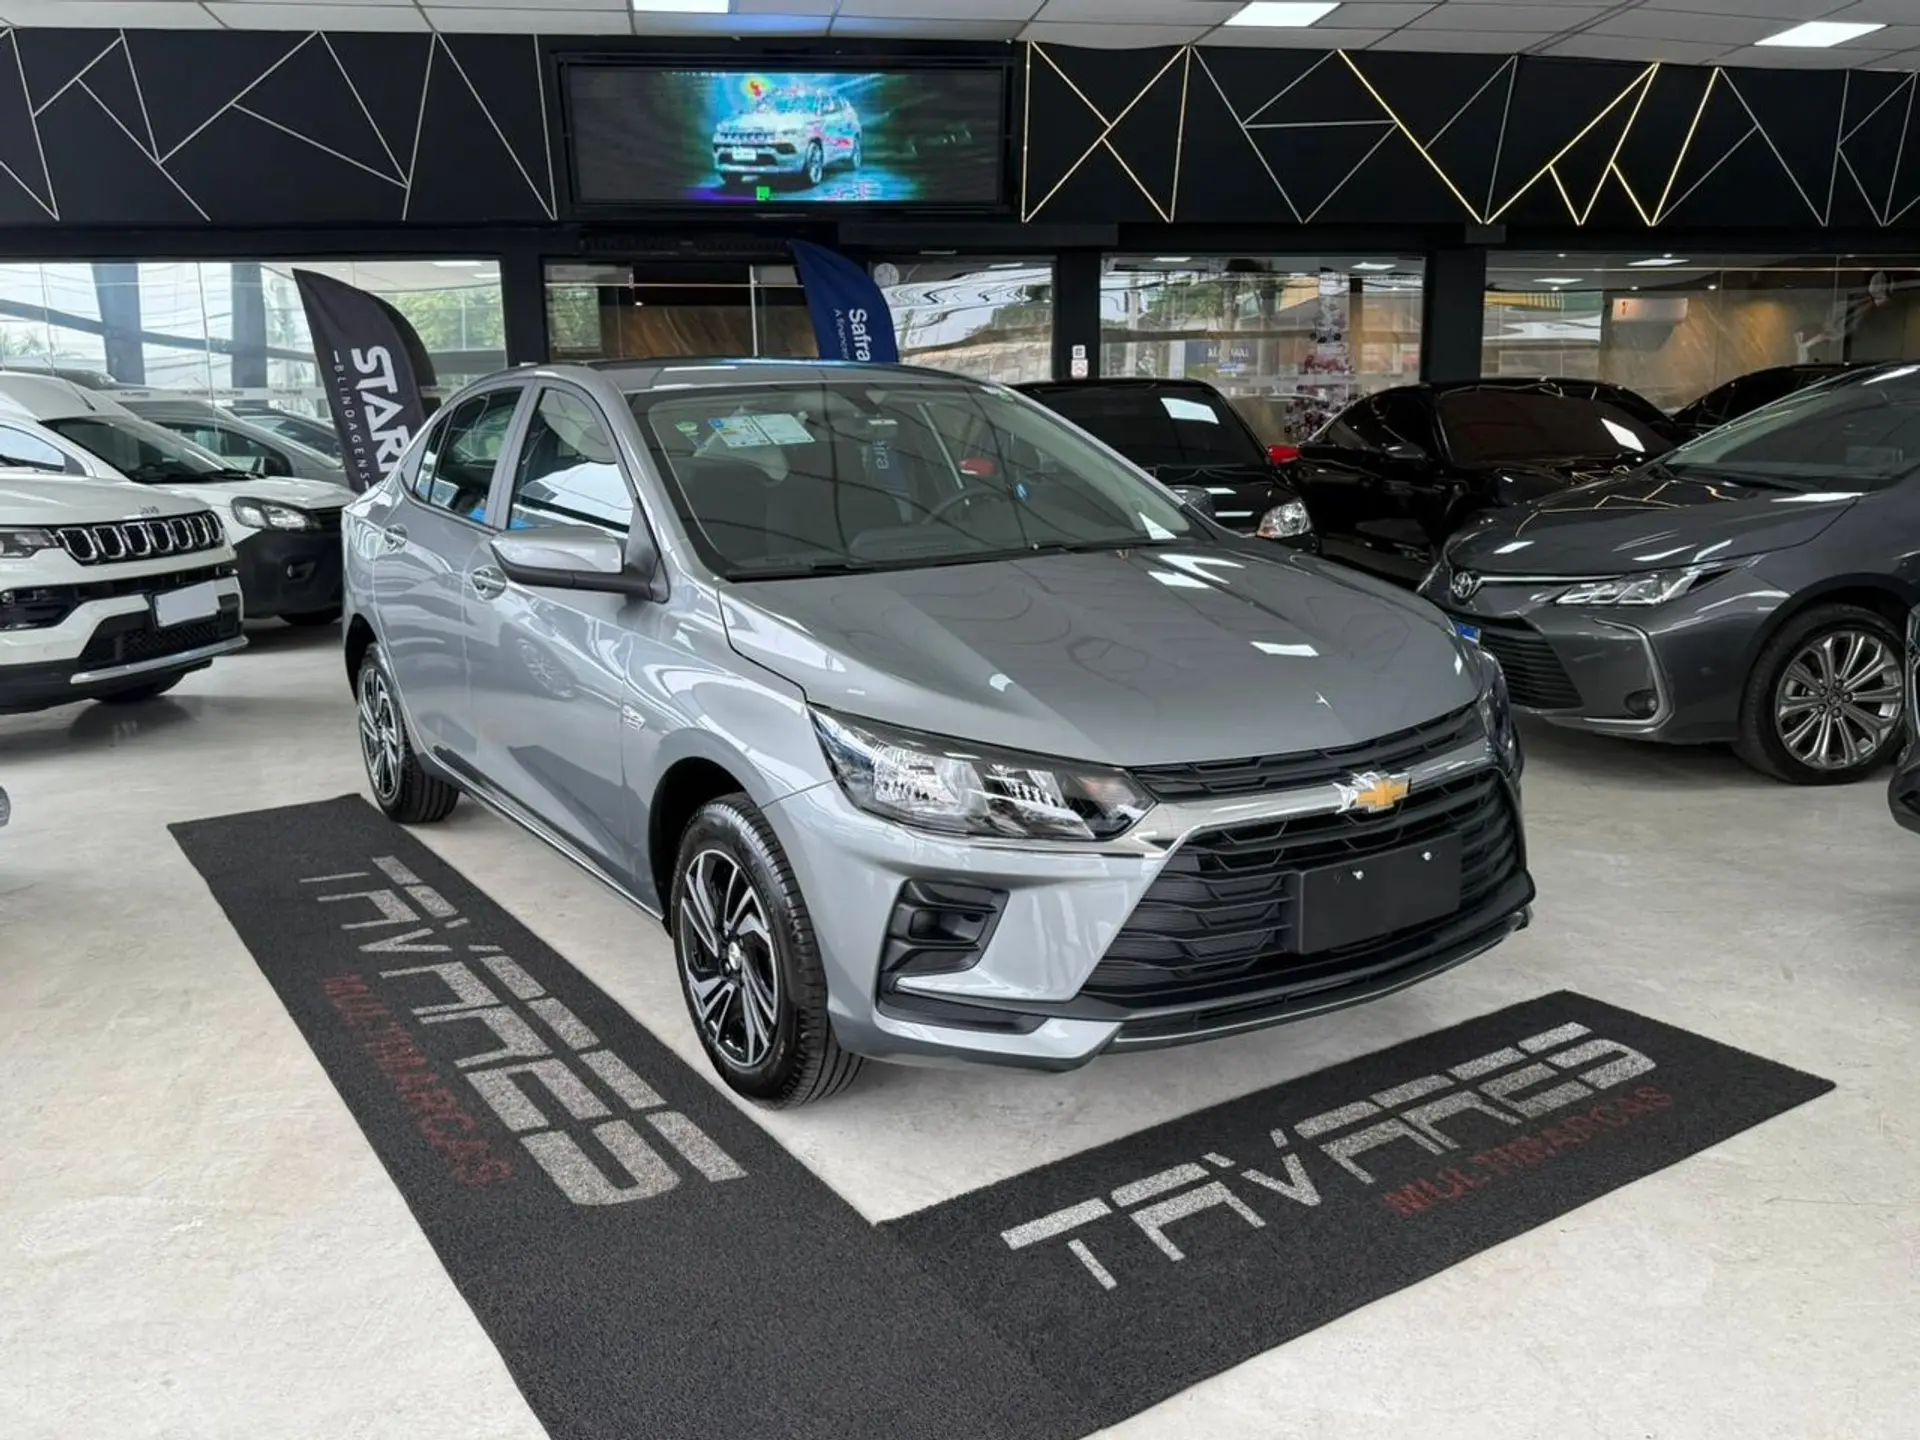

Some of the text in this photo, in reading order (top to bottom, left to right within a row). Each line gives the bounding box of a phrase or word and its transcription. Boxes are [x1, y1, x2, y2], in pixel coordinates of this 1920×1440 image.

[333, 363, 371, 479] BLINDAGENS
[848, 308, 872, 362] Safra
[299, 854, 750, 1207] TAVARES
[322, 972, 516, 1188] MULTIMARCAS
[1001, 1021, 1657, 1290] TAVARES
[1384, 1085, 1673, 1215] MULTIMARCAS
